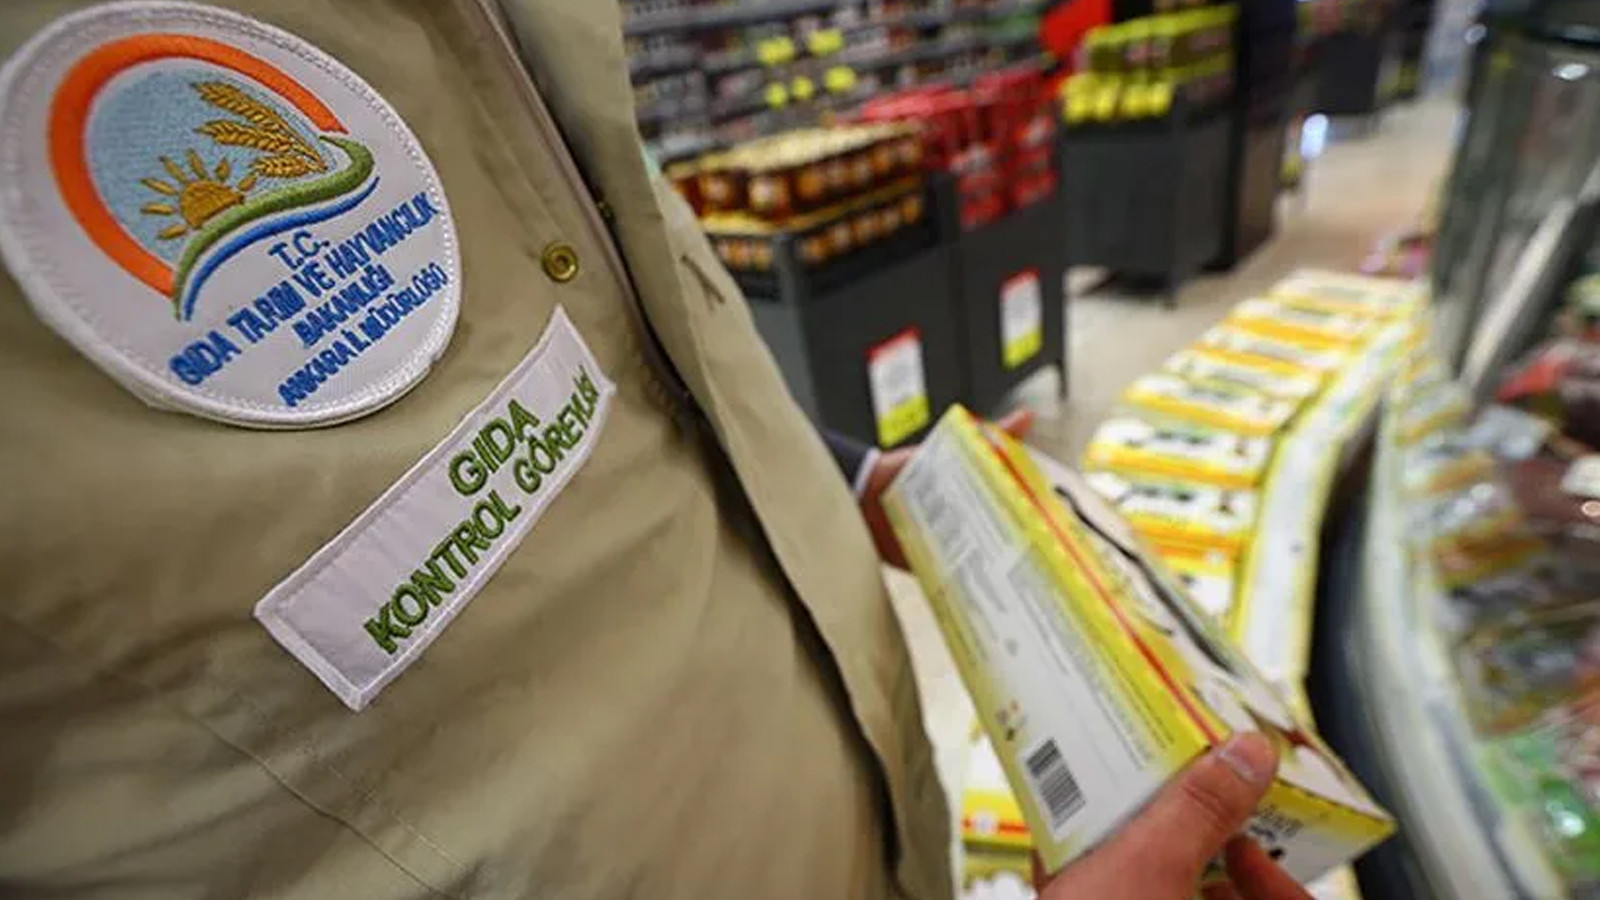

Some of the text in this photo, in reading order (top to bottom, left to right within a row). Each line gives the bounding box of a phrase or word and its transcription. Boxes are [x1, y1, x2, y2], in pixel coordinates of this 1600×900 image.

[169, 192, 439, 385] GIDA TARIM VE HAYVANCILIK
[269, 230, 331, 270] T.C.
[278, 340, 359, 407] ANKARA
[448, 399, 540, 496] GIDA
[363, 489, 522, 655] KONTROL
